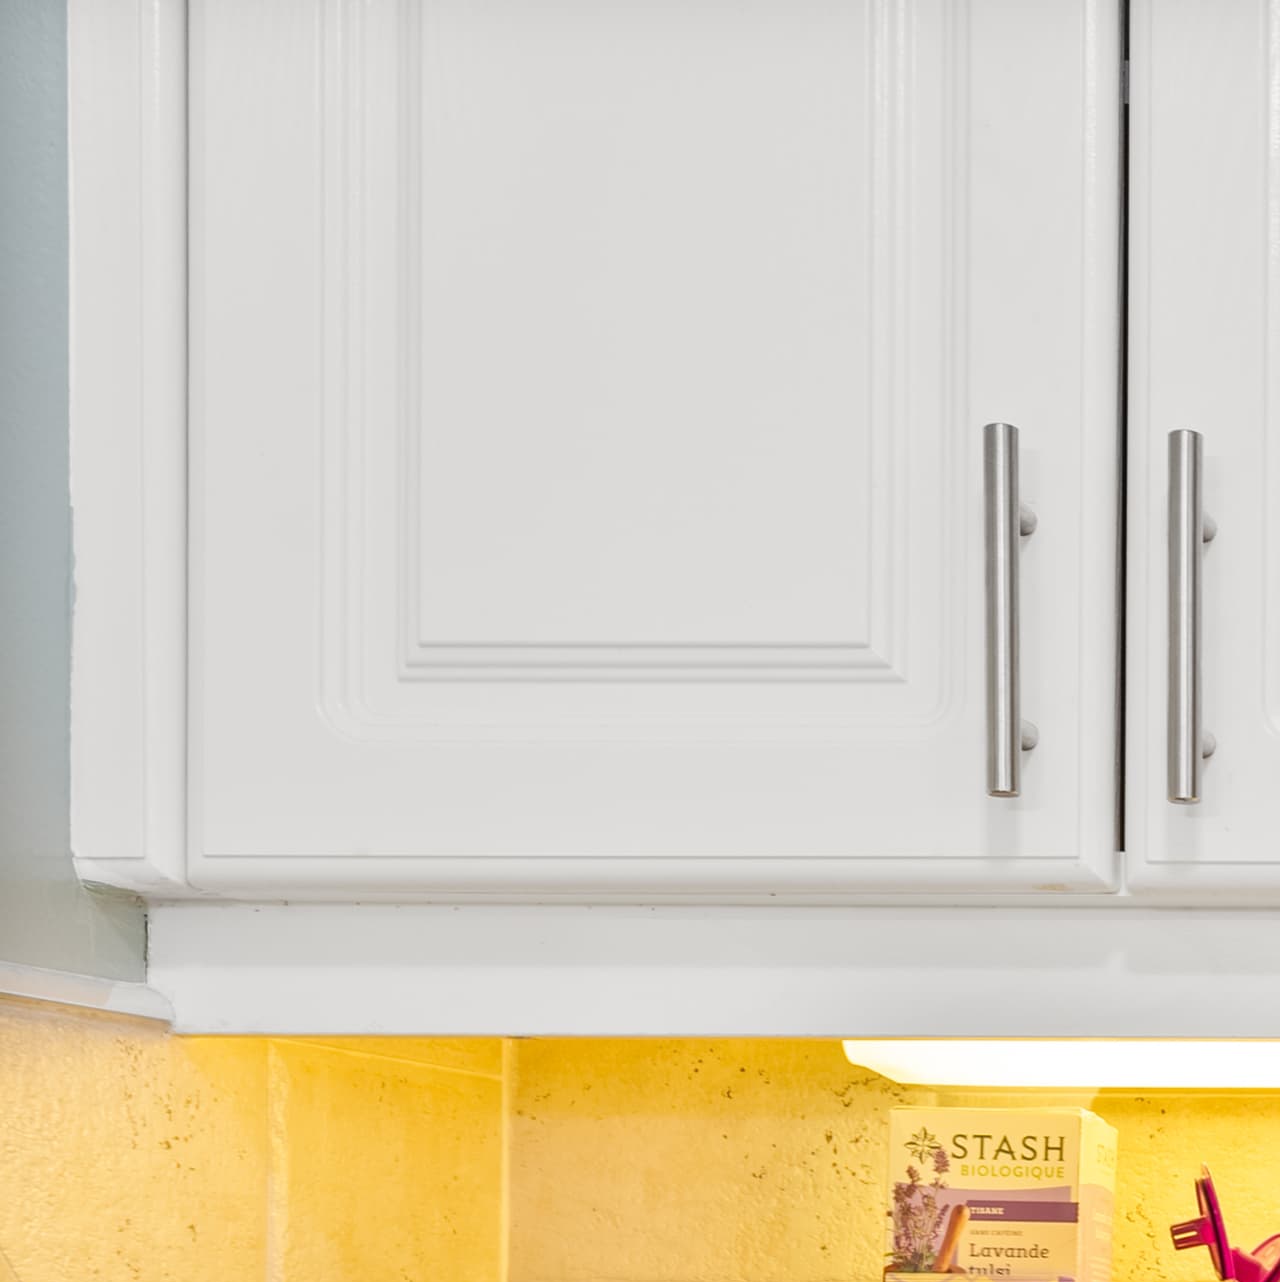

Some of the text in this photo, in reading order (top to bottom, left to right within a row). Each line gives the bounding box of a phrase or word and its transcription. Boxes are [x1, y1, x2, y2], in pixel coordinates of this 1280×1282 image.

[951, 1133, 1065, 1162] STASH
[960, 1164, 1065, 1180] BIOLOGIQUE
[969, 1206, 1004, 1216] TISANE
[968, 1242, 1050, 1259] Lavande
